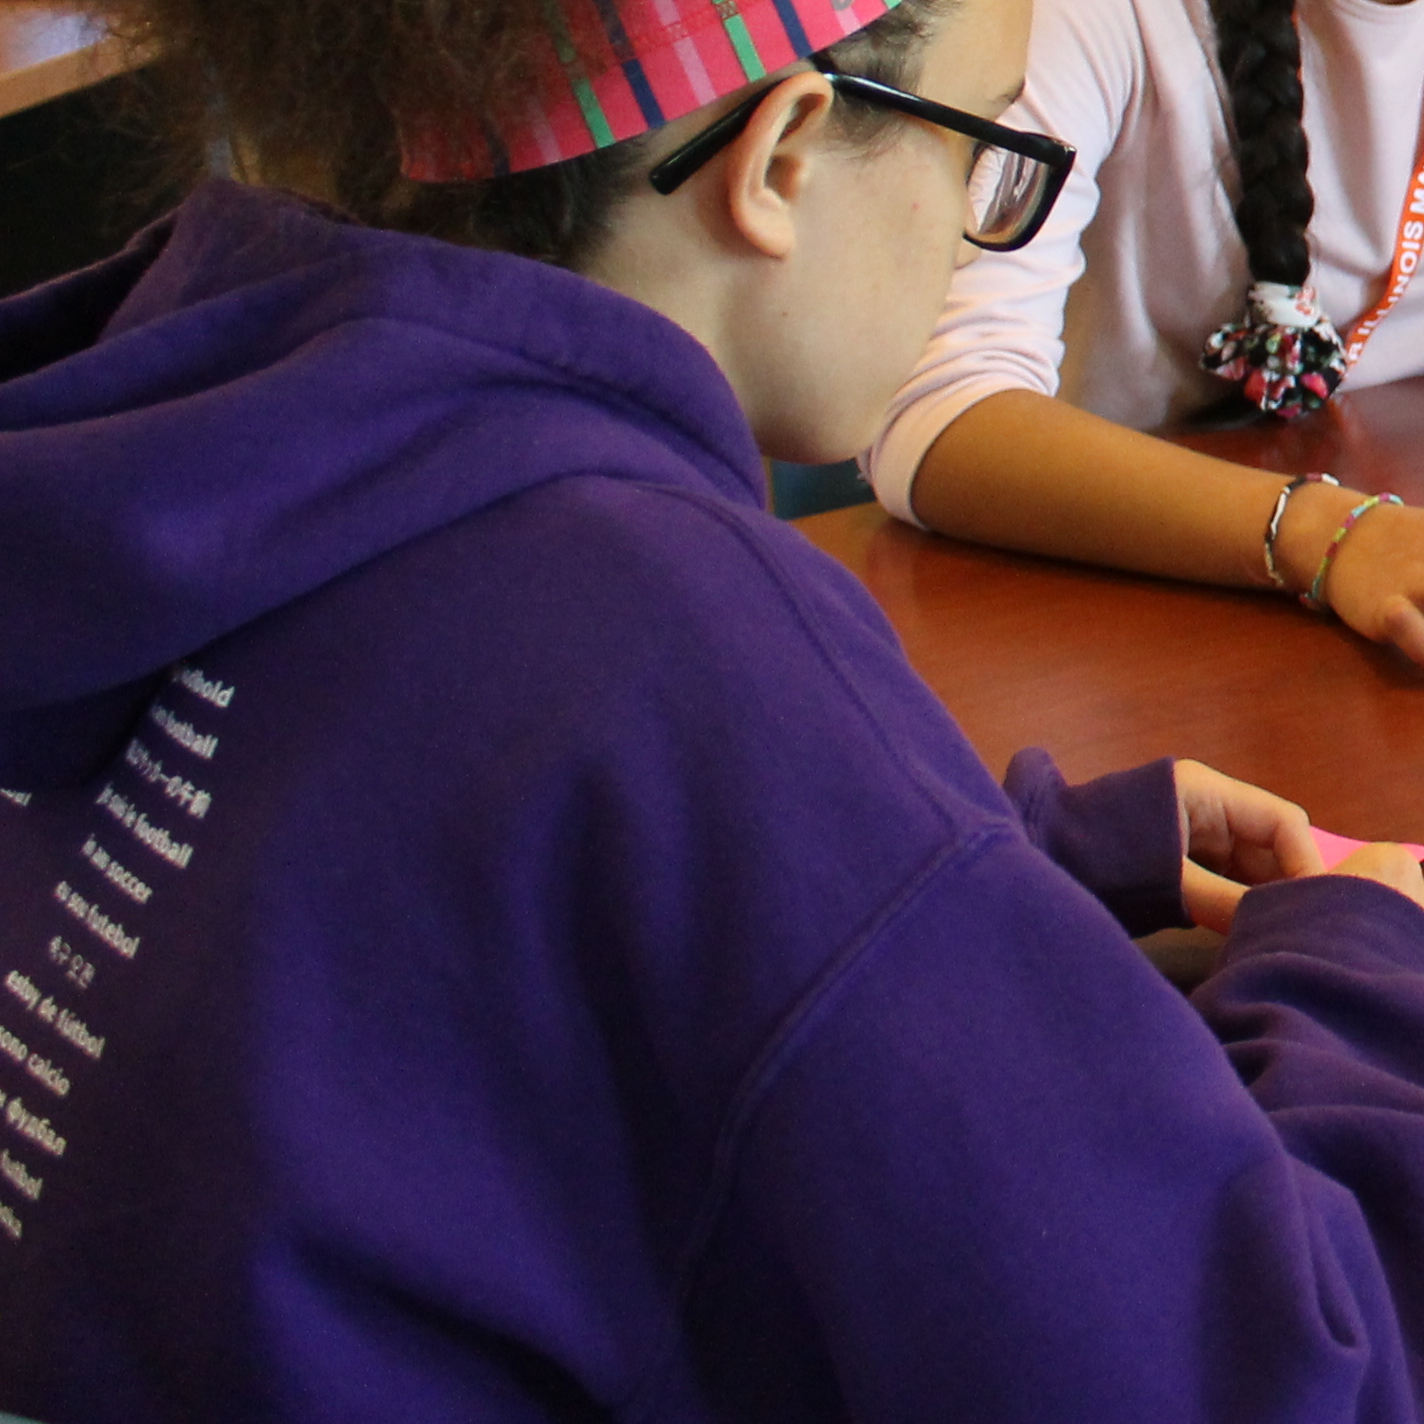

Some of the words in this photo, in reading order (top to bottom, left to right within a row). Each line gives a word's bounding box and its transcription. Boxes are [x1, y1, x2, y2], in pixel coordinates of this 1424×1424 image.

[1357, 219, 1424, 335] ILLINOIS
[132, 813, 194, 870] football
[105, 860, 153, 905] soccer
[86, 903, 141, 960] futebol
[5, 968, 42, 1011] estoy
[37, 994, 59, 1024] de
[26, 1051, 71, 1098] calcio
